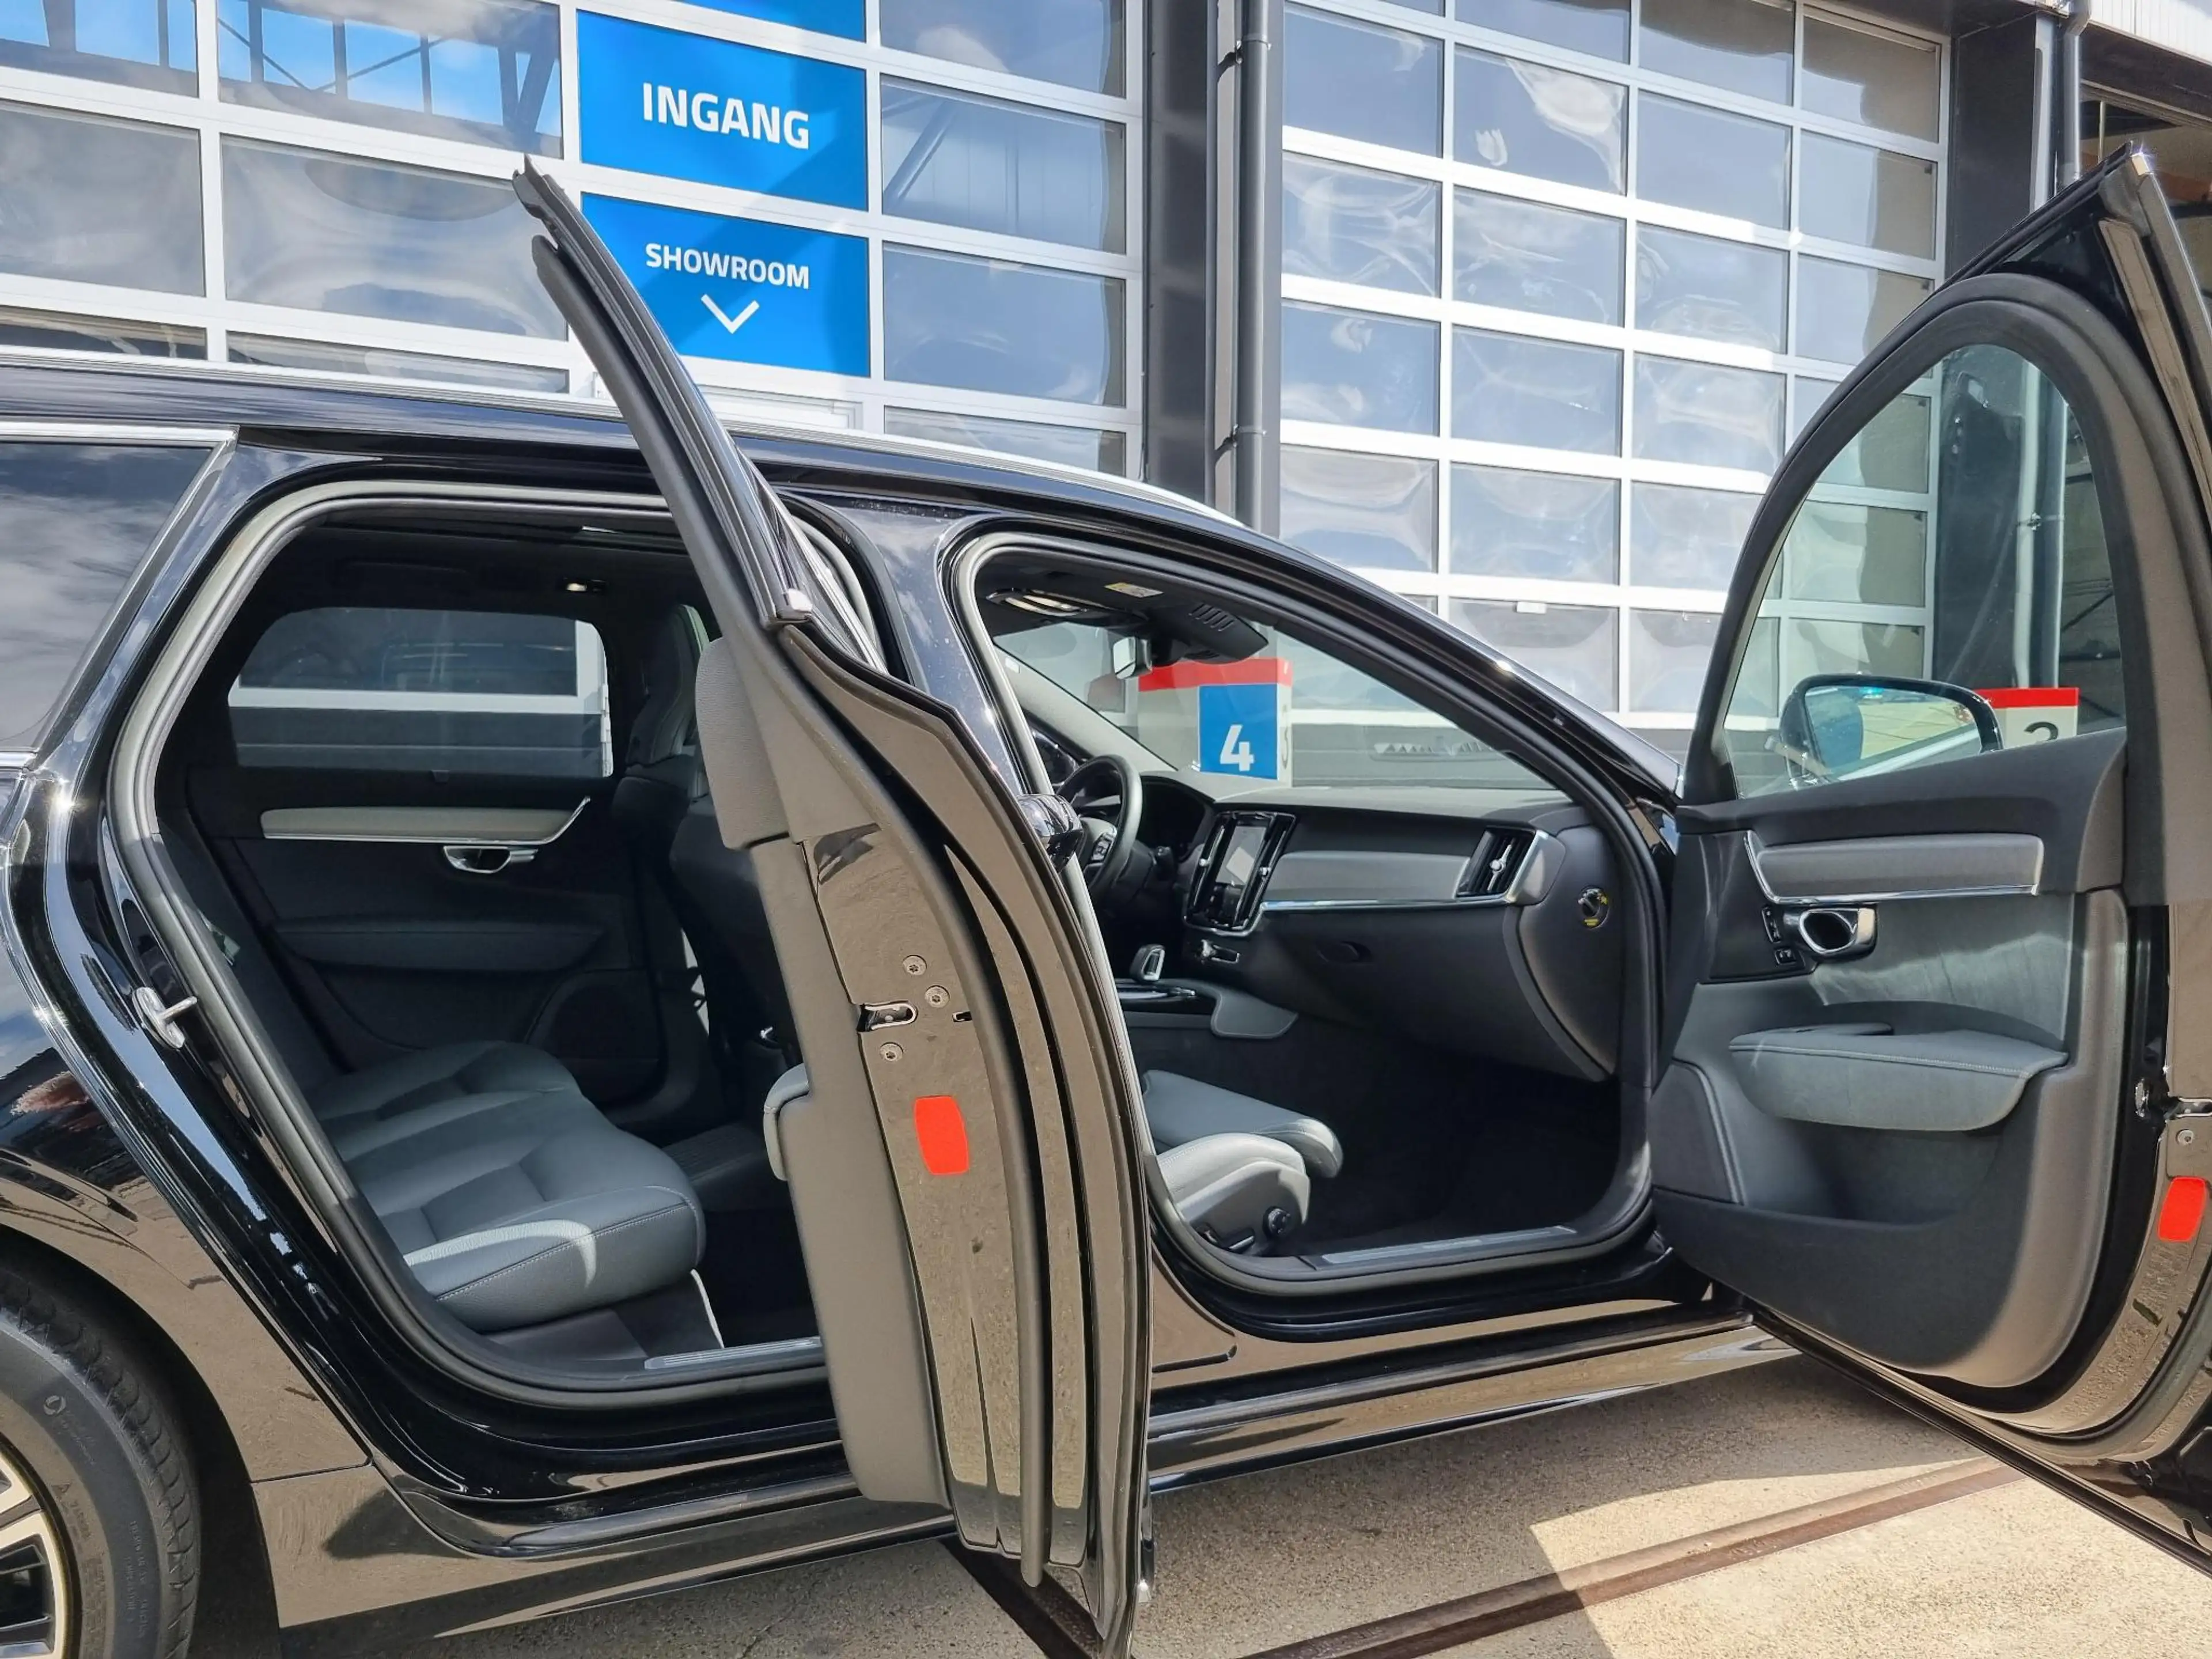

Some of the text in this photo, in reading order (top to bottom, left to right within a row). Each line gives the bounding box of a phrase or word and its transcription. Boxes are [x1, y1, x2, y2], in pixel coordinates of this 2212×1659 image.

[643, 82, 809, 149] INGANG
[645, 243, 809, 289] SHOWROOM
[1219, 724, 1255, 772] 4
